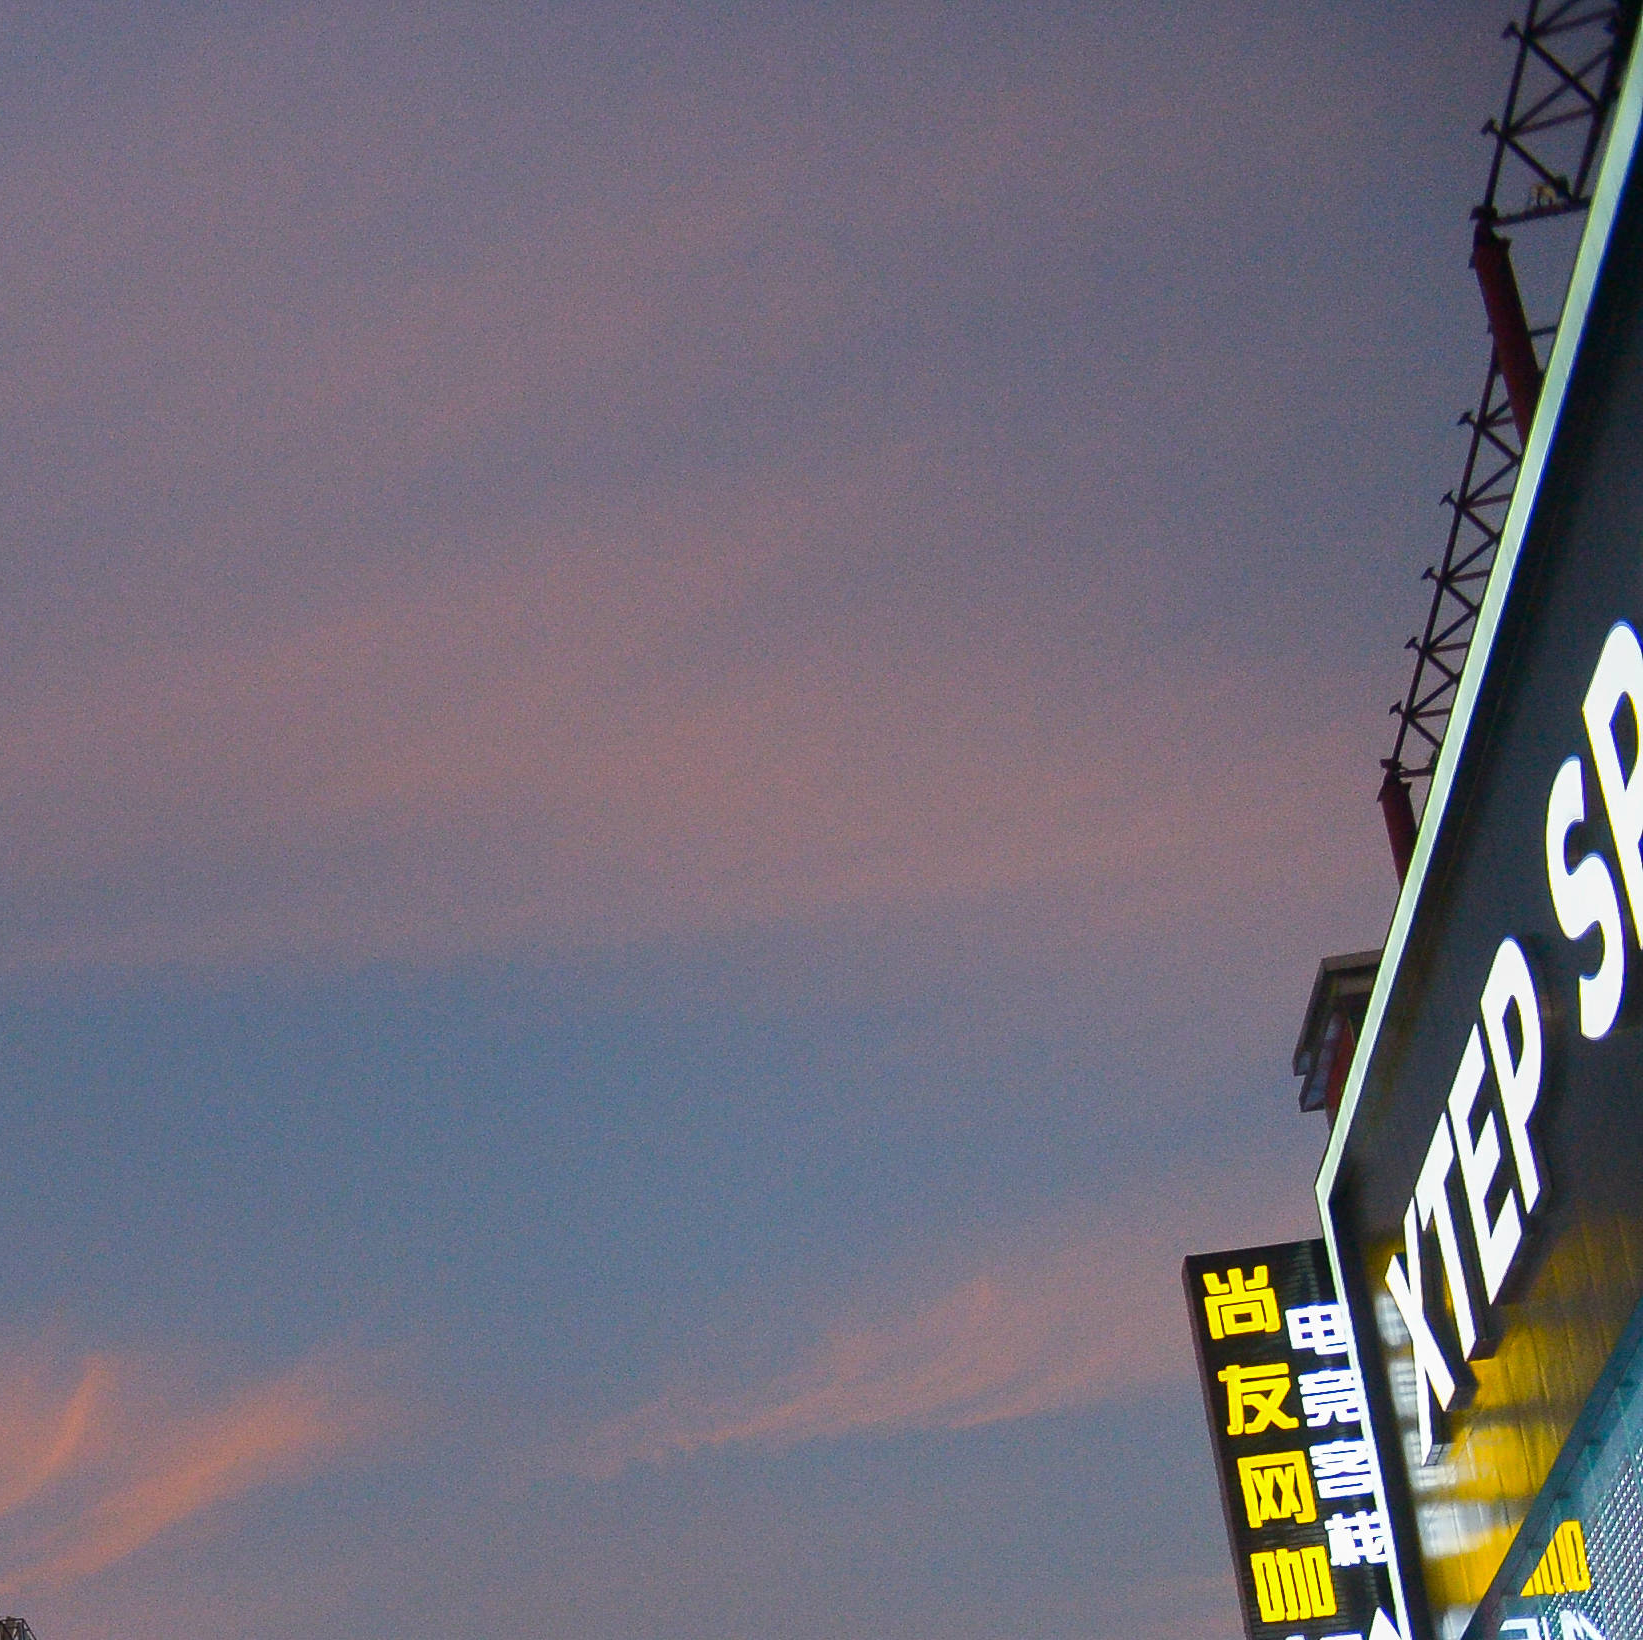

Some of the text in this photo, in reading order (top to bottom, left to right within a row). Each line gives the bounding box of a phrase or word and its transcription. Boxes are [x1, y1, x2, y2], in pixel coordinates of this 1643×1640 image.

[1384, 936, 1542, 1466] XTEP
[1202, 1264, 1337, 1624] 尚友网咖
